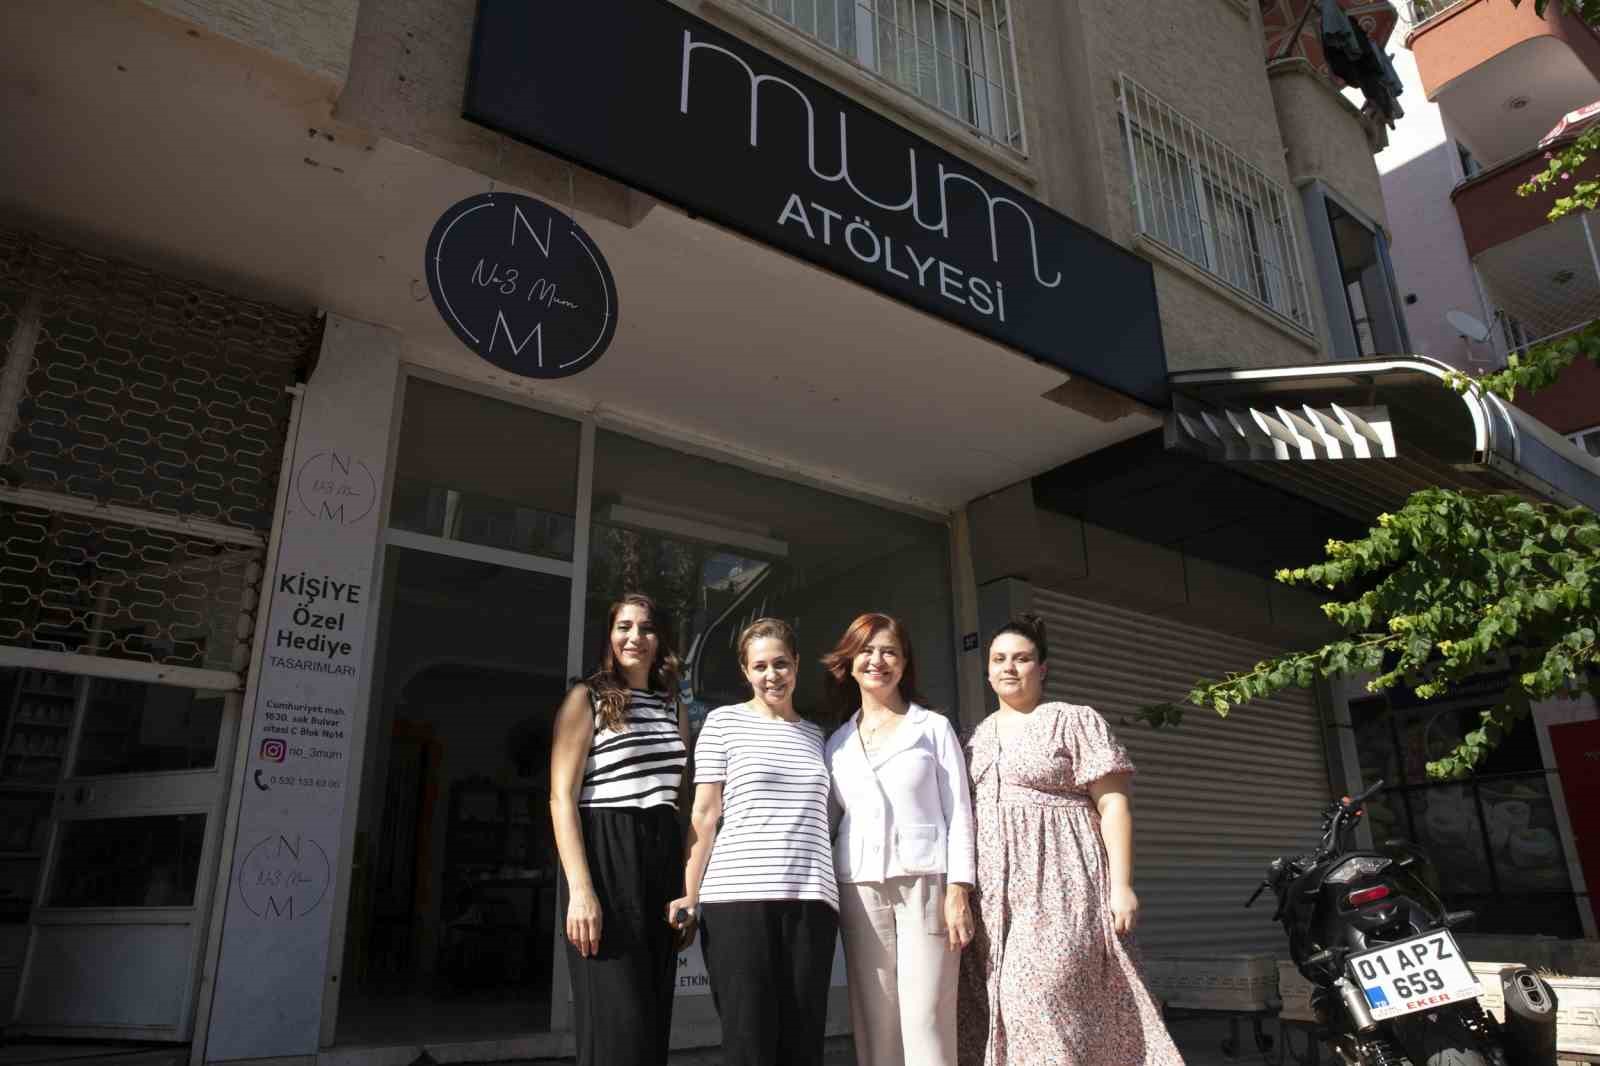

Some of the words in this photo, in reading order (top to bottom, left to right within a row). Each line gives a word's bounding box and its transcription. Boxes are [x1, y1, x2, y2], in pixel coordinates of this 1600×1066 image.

[680, 28, 1062, 288] mum
[511, 204, 553, 259] N
[777, 192, 1005, 323] ATÖLYESİ
[488, 308, 543, 368] M
[330, 451, 351, 475] N
[319, 501, 344, 524] M
[279, 572, 361, 604] KİŞİYE
[293, 603, 344, 631] Özel
[277, 630, 352, 659] Hediye
[270, 656, 358, 678] TASARIMLARI
[278, 834, 301, 859] N
[265, 896, 293, 920] M
[1358, 955, 1390, 980] 01
[1397, 937, 1453, 971] APZ
[1392, 968, 1445, 999] 659
[1406, 993, 1450, 1010] EKER
